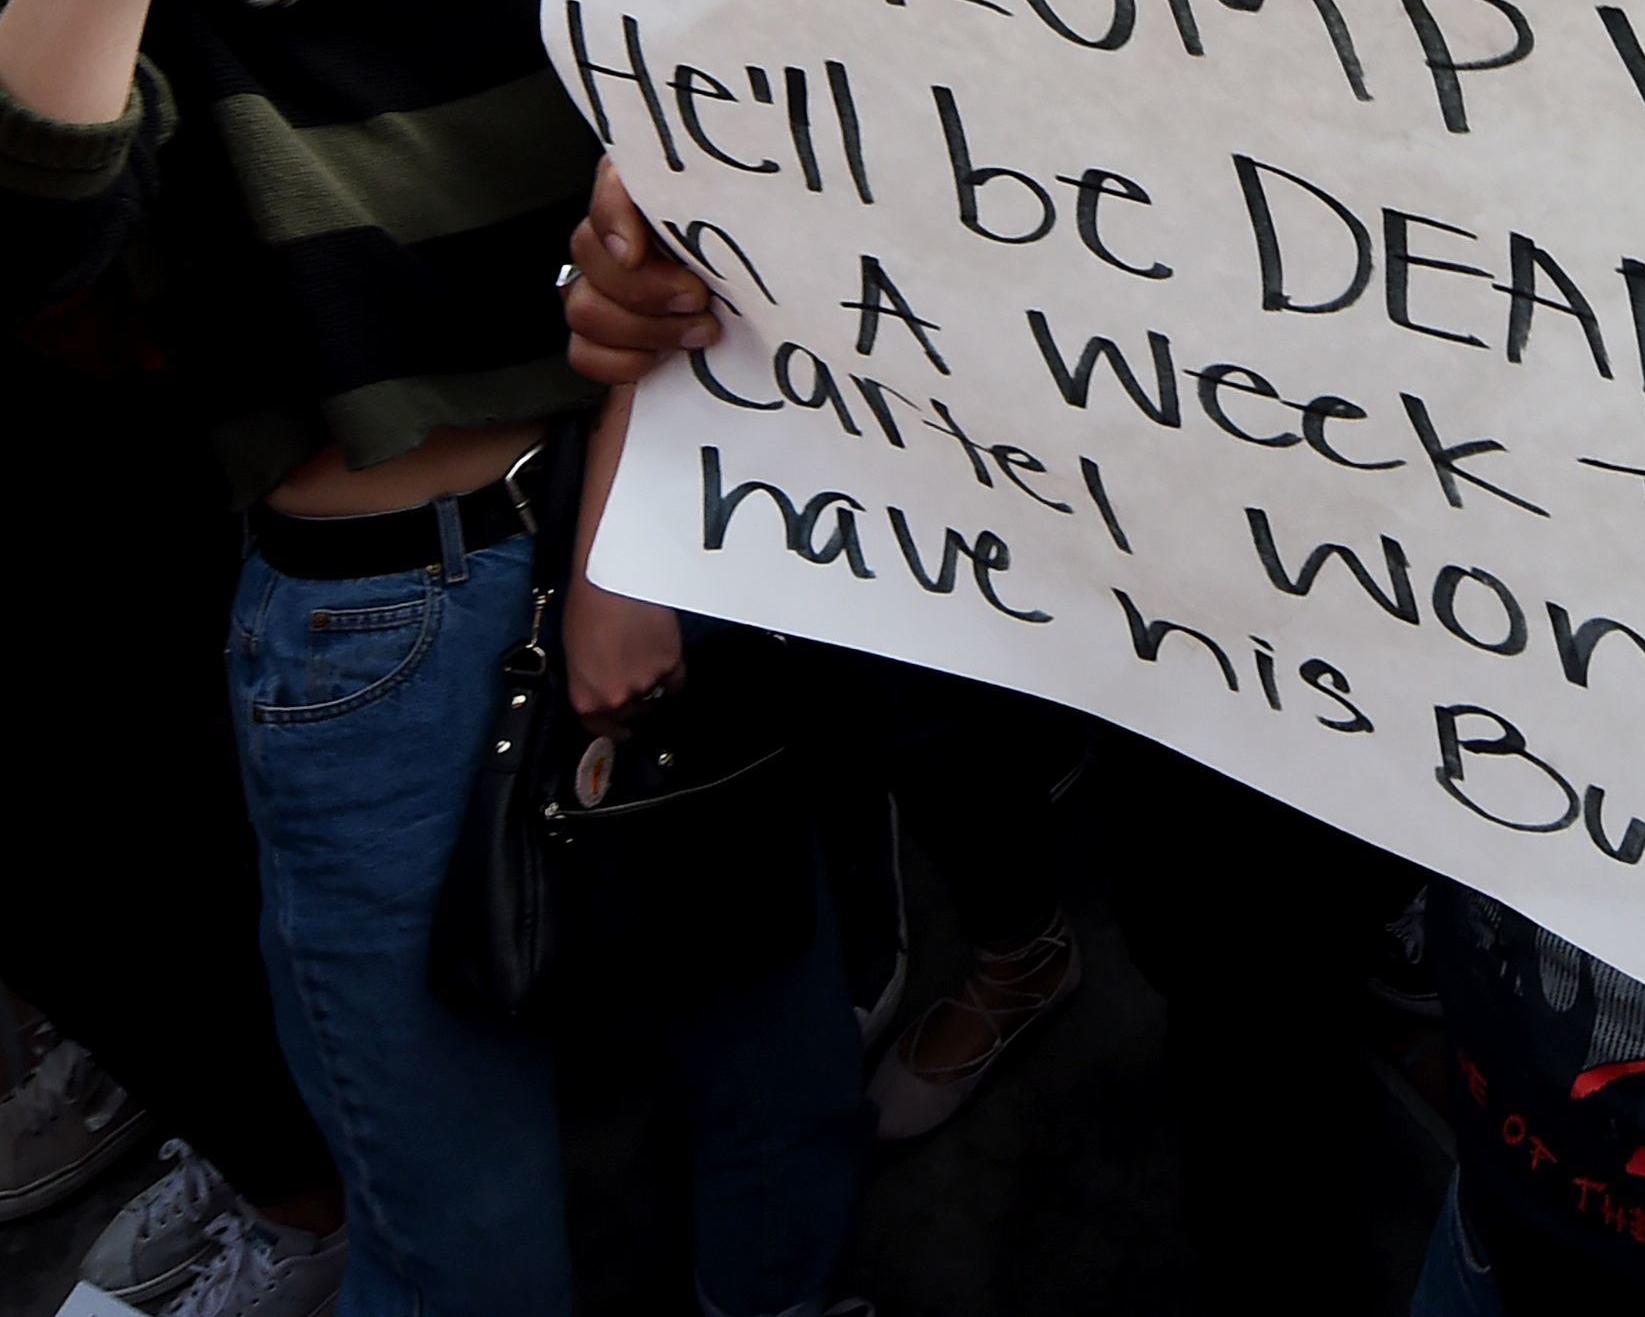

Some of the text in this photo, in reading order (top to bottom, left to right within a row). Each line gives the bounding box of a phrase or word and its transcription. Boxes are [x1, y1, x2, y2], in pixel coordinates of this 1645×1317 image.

[567, 0, 873, 205] He'll
[931, 85, 1173, 282] be
[840, 252, 952, 376] A
[699, 445, 1055, 623] have
